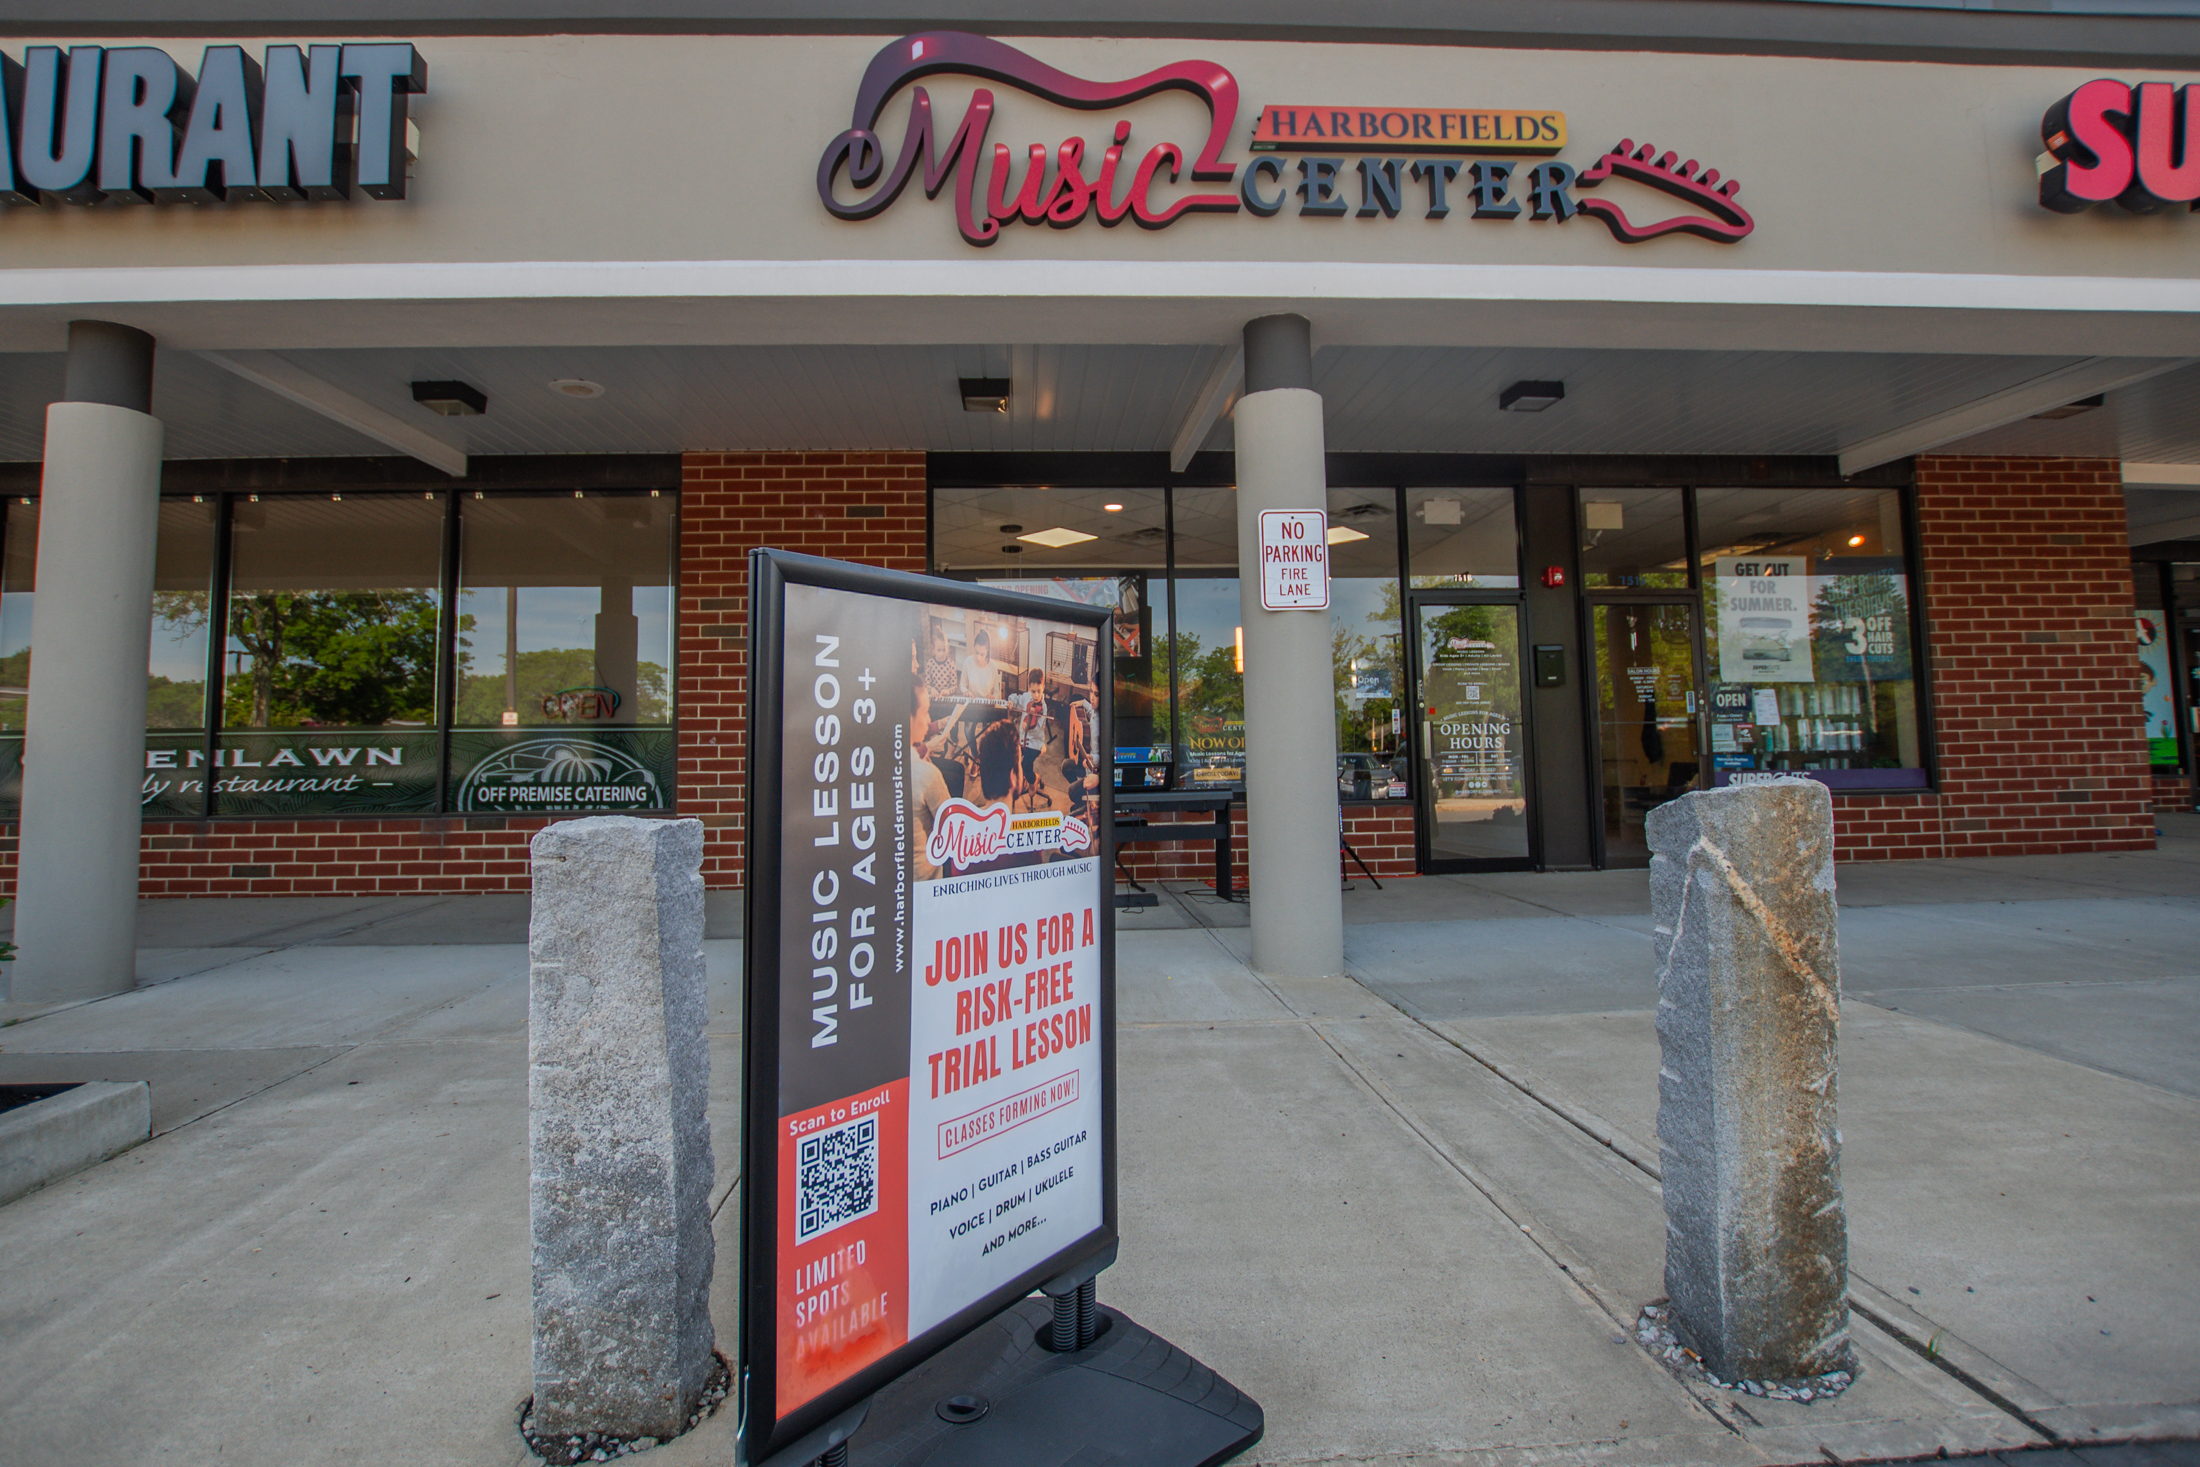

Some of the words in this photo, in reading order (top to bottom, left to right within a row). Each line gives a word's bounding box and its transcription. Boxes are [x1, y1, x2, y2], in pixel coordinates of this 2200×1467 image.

[0, 44, 415, 195] URANT
[1271, 110, 1559, 142] HARBORFIELDS
[2056, 78, 2200, 206] SU
[818, 84, 1185, 246] Music
[1241, 156, 1578, 221] CENTER
[1282, 522, 1304, 539] NO
[1265, 544, 1323, 562] PARKING
[1735, 562, 1760, 576] GET
[1764, 562, 1789, 576] CUT
[1280, 583, 1311, 596] LANE
[1281, 568, 1308, 580] FIRE
[1749, 580, 1776, 594] FOR
[1730, 597, 1797, 612] SUMMER.
[1866, 616, 1892, 631] OFF
[1867, 632, 1893, 642] HAIR
[1867, 643, 1894, 654] CUTS
[853, 667, 877, 725] 3+
[1358, 675, 1379, 685] Open
[541, 693, 614, 718] OPEN
[1716, 693, 1747, 707] OPEN
[813, 634, 841, 847] LESSON
[1188, 736, 1226, 751] NOW
[1440, 723, 1511, 735] OPENING
[1450, 737, 1503, 749] HOURS
[146, 747, 403, 768] ENLAWN
[179, 774, 364, 793] restaurant
[477, 786, 507, 802] OFF
[509, 786, 573, 802] PREMISE
[574, 786, 647, 802] CATERING
[851, 745, 876, 885] AGES
[1011, 818, 1060, 830] HARBORFIELDS
[892, 723, 905, 974] www.harborfieldsmusic.com
[931, 820, 998, 863] Music
[1006, 829, 1061, 849] CENTER
[933, 877, 992, 897] ENRICHING
[994, 874, 1019, 888] LIVES
[1020, 866, 1065, 884] THROUGH
[1066, 862, 1092, 876] MUSIC
[811, 869, 840, 1049] MUSIC
[849, 905, 876, 1010] FOR
[925, 930, 988, 987] JOIN
[998, 922, 1028, 969] US
[1036, 912, 1074, 960] FOR
[1081, 907, 1095, 948] A
[955, 960, 1074, 1036] RISK-FREE
[928, 1035, 1001, 1100] TRIAL
[1012, 1003, 1091, 1071] LESSON
[789, 1115, 825, 1136] Scan
[830, 1108, 846, 1122] to
[850, 1089, 890, 1116] Enroll
[945, 1111, 995, 1148] CLASSES
[999, 1090, 1047, 1126] FORMING
[1050, 1078, 1075, 1104] NOW!
[930, 1188, 968, 1215] PIANO
[978, 1164, 1018, 1191] GUITAR
[1027, 1147, 1051, 1169] BASS
[1053, 1130, 1087, 1155] GUITAR
[949, 1212, 985, 1240] VOICE
[995, 1191, 1026, 1217] DRUM
[1035, 1166, 1074, 1196] UKULELE
[981, 1234, 1005, 1257] AND
[1008, 1216, 1047, 1244] MORE...
[796, 1240, 866, 1295] LIMITED
[796, 1280, 850, 1328] SPOTS
[796, 1291, 888, 1363] AVAILABLE
